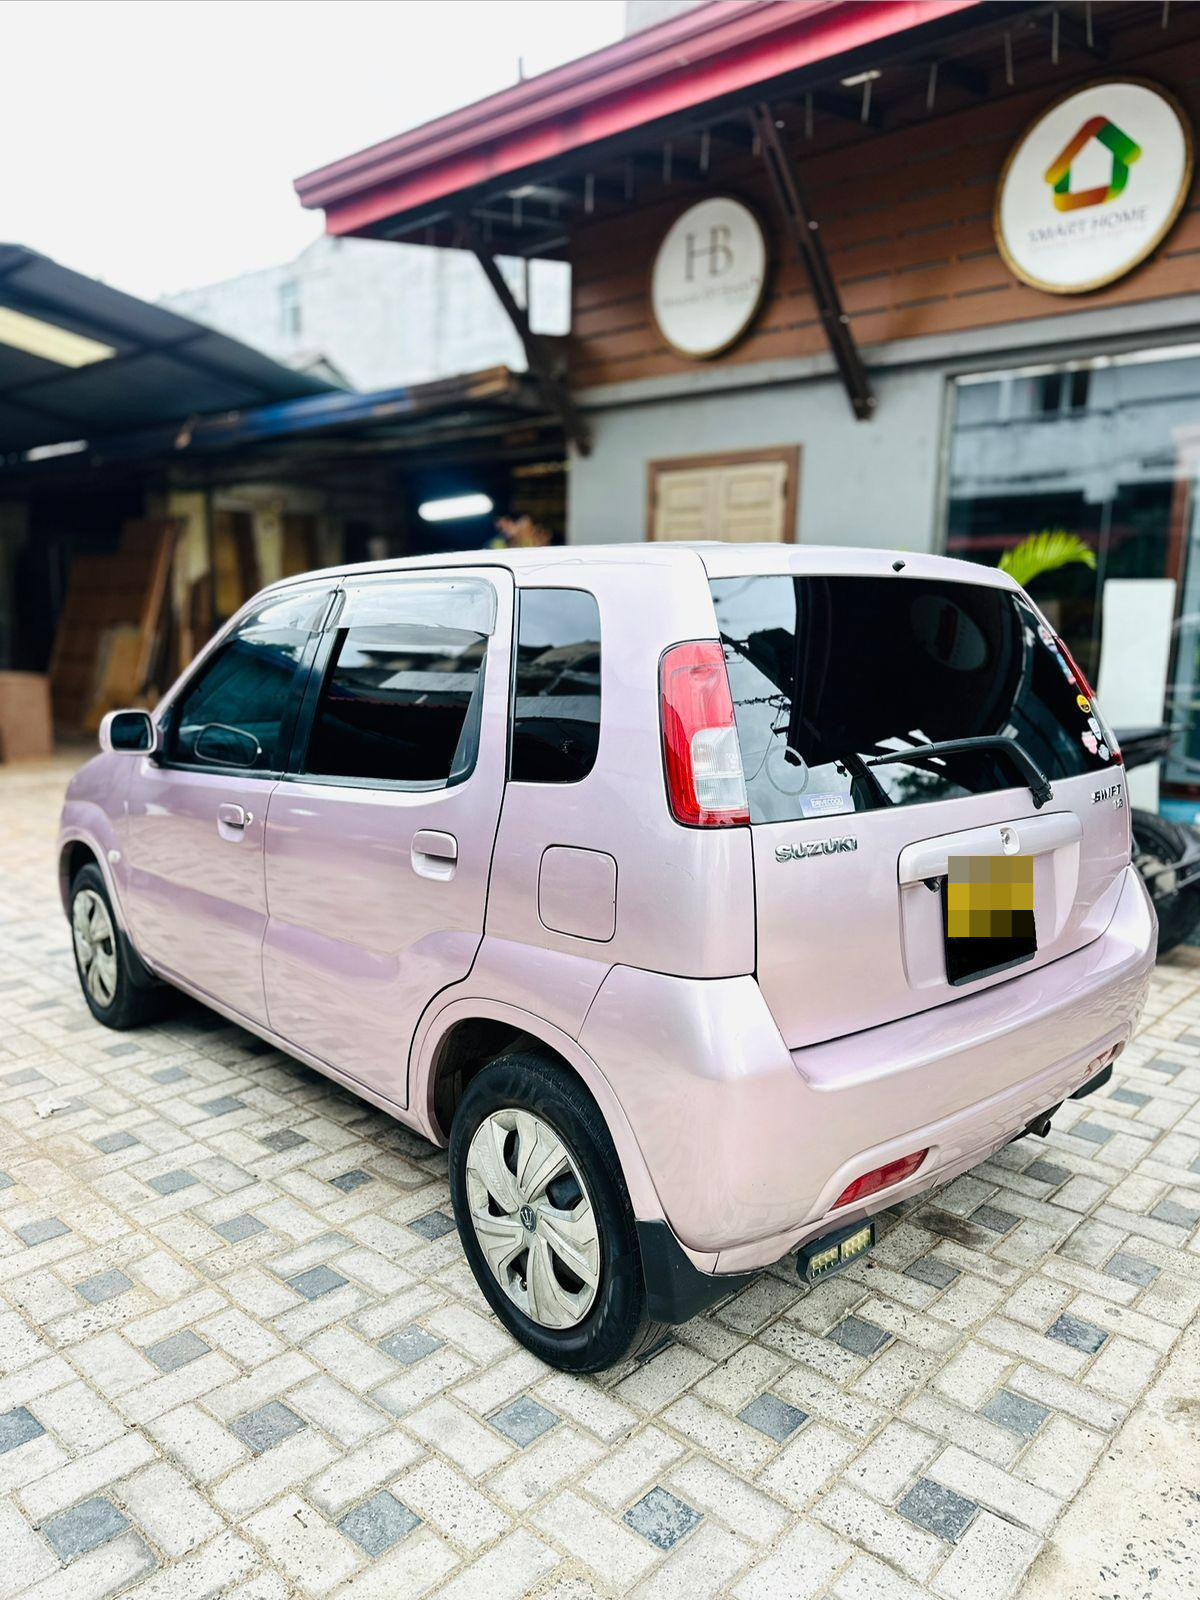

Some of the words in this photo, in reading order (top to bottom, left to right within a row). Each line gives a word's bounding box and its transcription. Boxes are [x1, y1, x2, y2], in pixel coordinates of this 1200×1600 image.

[1091, 206, 1149, 229] HOME
[685, 224, 735, 282] HB
[1092, 784, 1121, 804] SWIFT
[775, 835, 858, 863] SUZUKI
